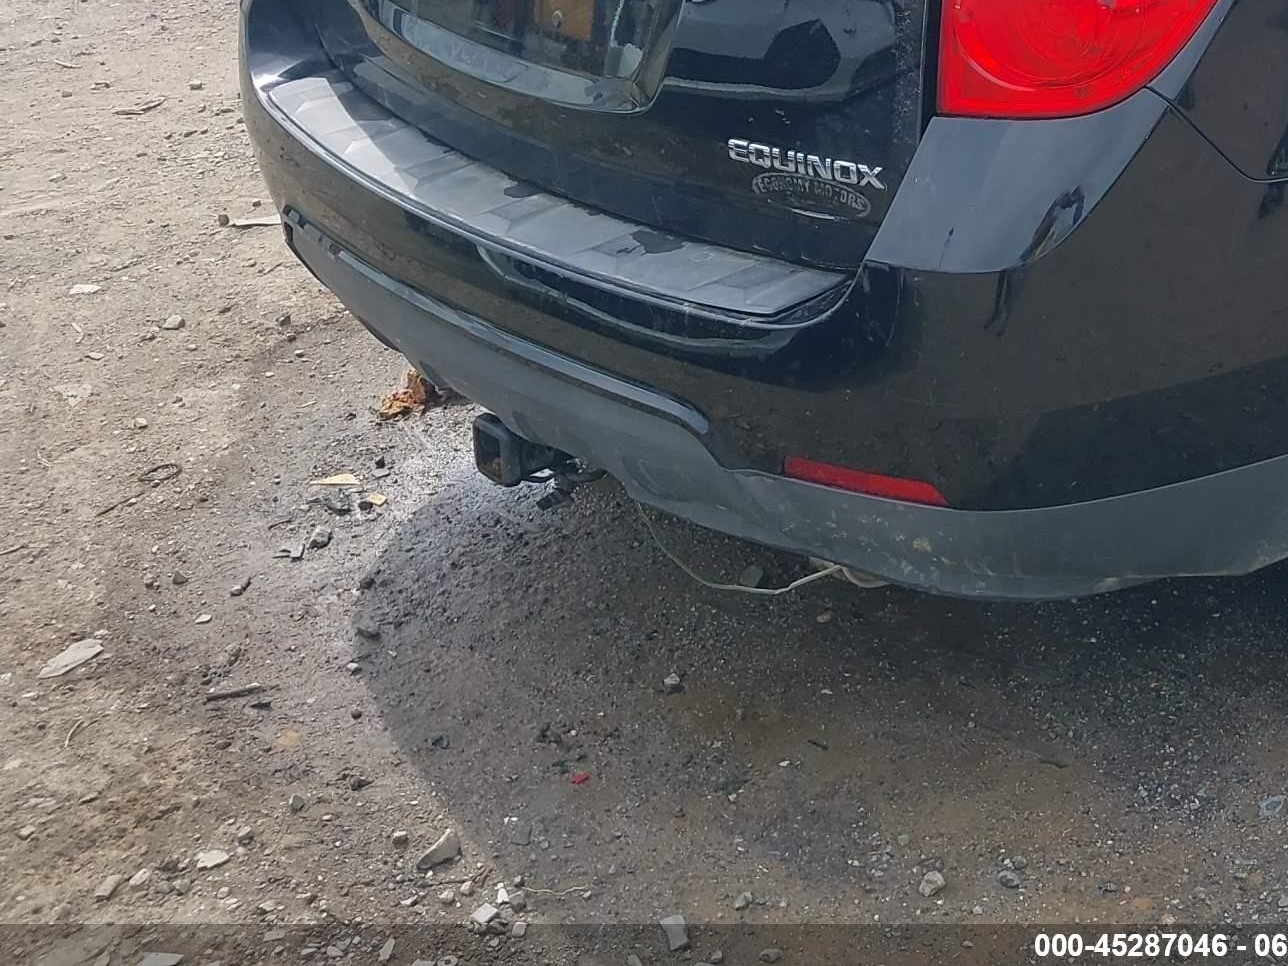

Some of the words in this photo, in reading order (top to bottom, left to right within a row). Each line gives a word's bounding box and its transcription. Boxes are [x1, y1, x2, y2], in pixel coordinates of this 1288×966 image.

[727, 138, 885, 189] EQUINOX
[757, 175, 810, 194] ECONOMY
[814, 182, 866, 211] MOTORS
